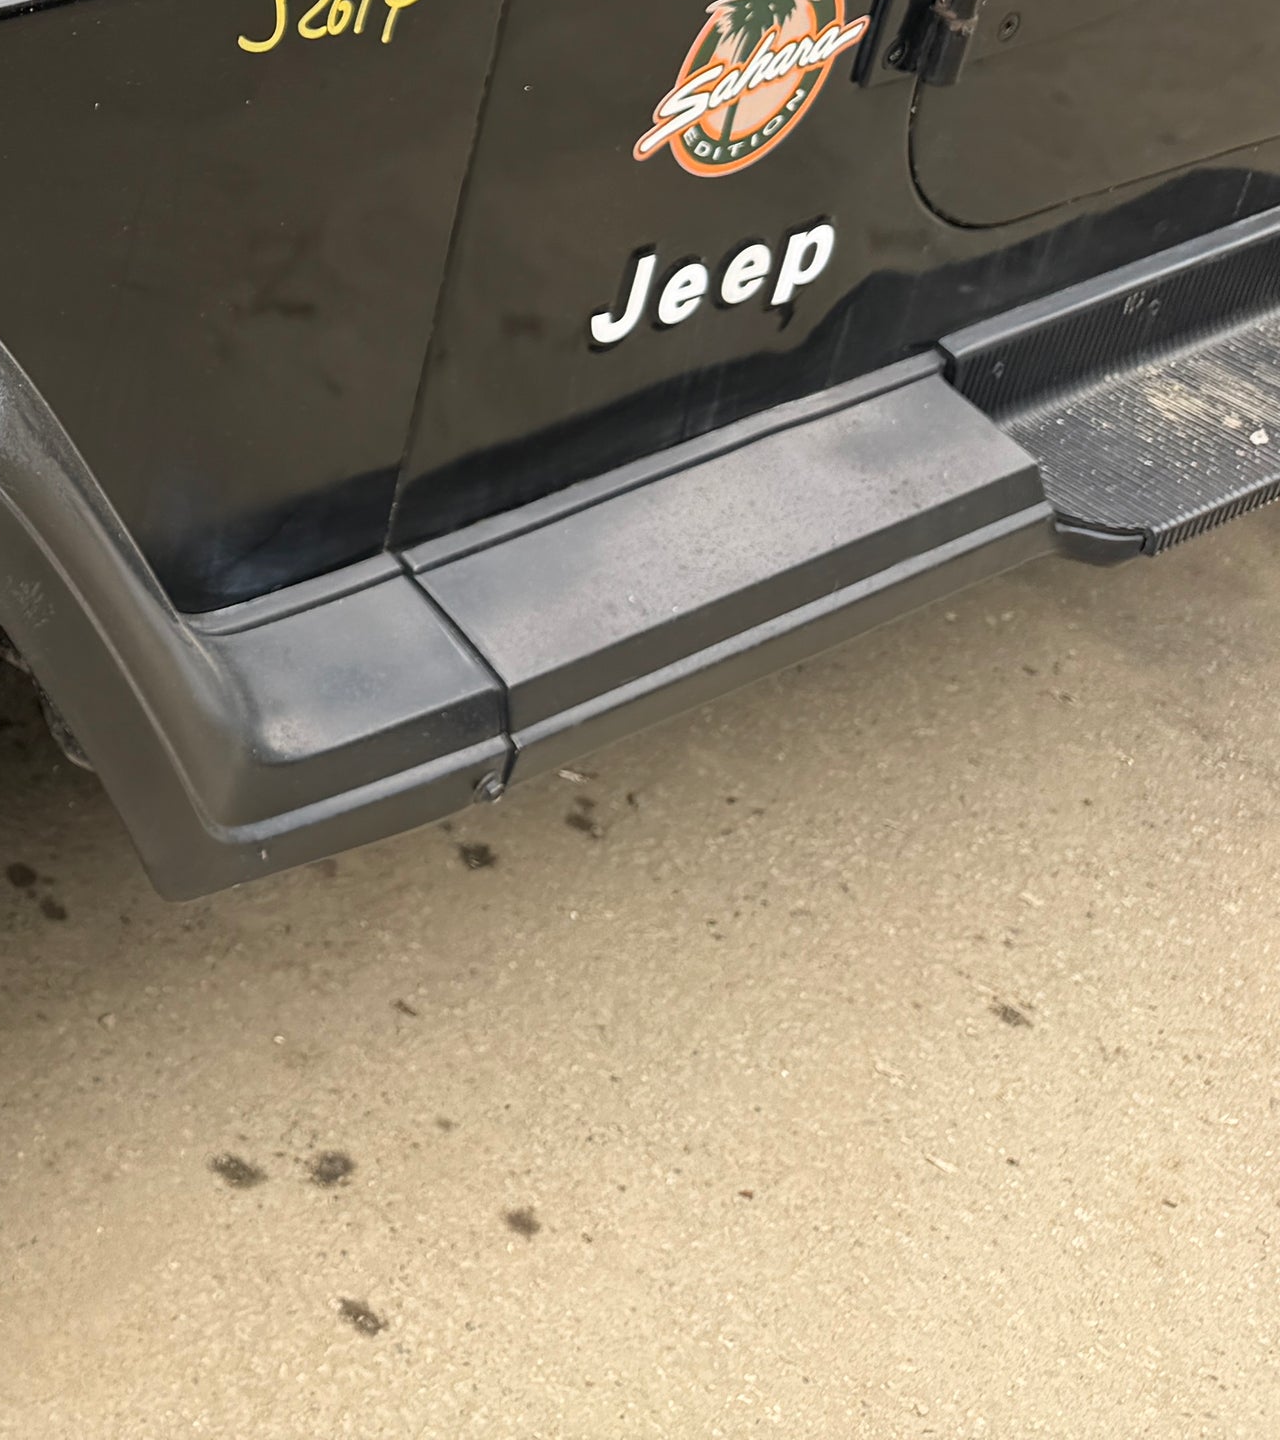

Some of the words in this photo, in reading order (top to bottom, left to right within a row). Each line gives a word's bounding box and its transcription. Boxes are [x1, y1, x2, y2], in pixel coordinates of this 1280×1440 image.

[636, 17, 869, 157] Sahara
[682, 88, 806, 161] EDITION
[590, 223, 835, 344] Jeep
